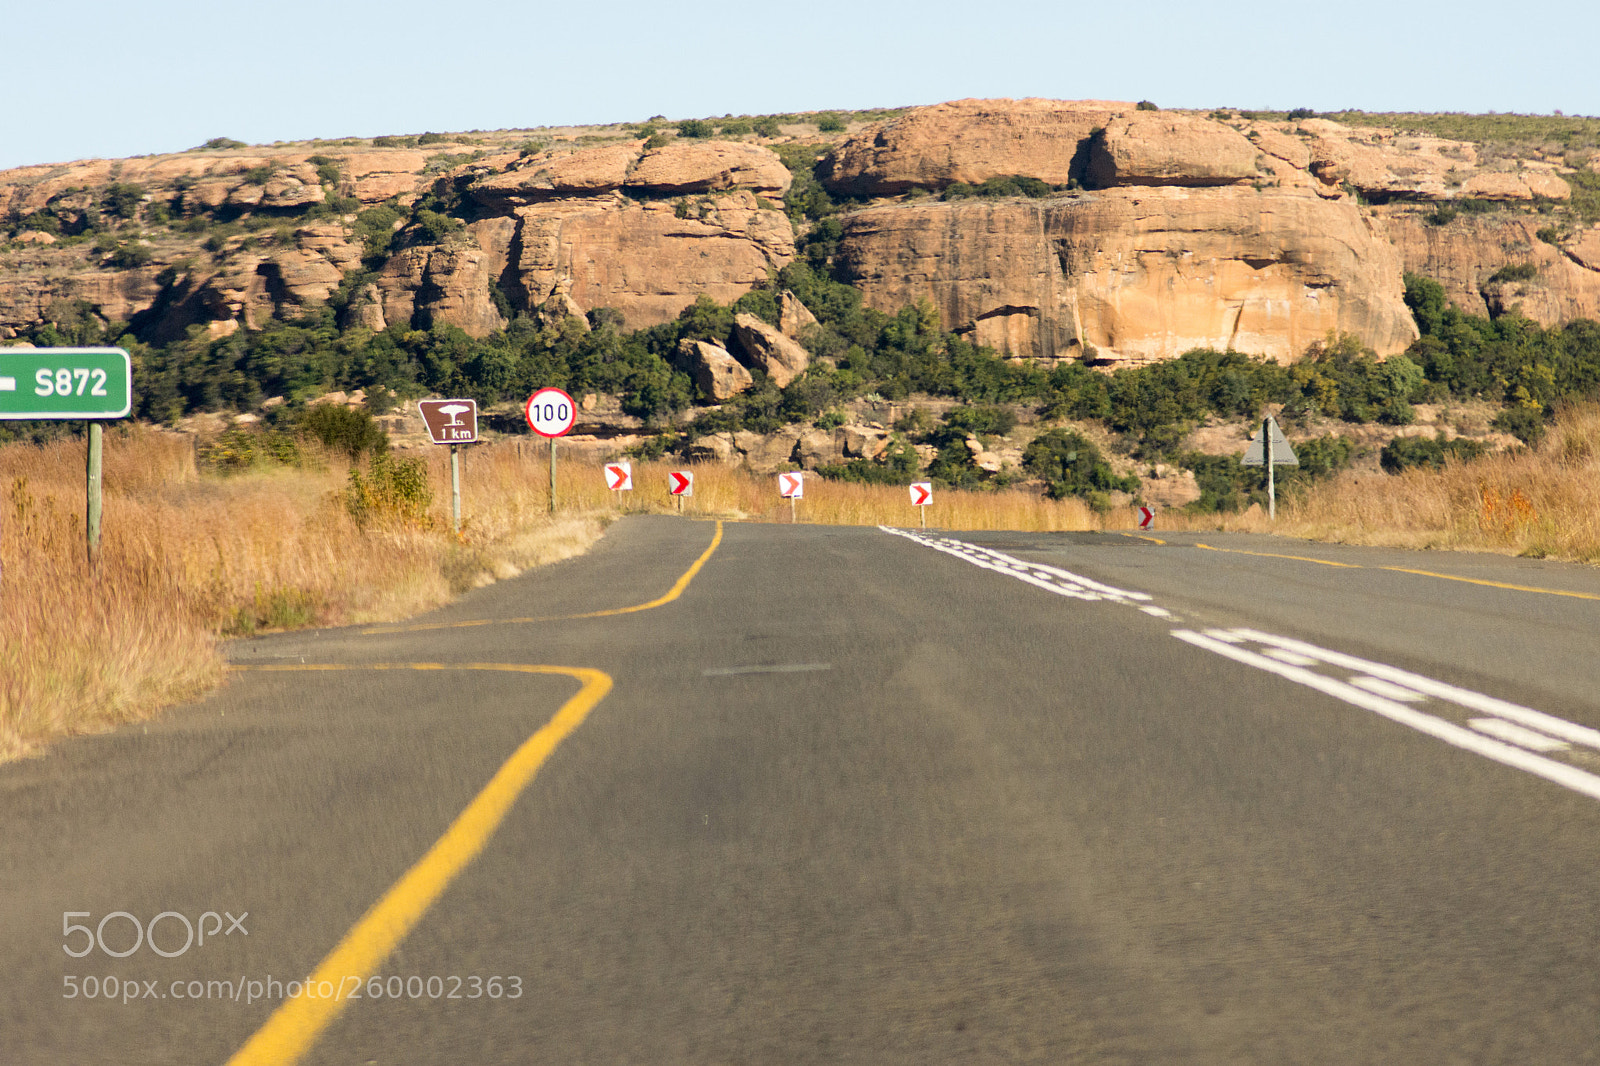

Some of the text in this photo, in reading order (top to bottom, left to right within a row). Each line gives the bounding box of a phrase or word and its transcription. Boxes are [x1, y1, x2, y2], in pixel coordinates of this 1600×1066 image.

[35, 367, 108, 397] S872
[533, 403, 568, 422] 100
[440, 428, 472, 440] 1 km
